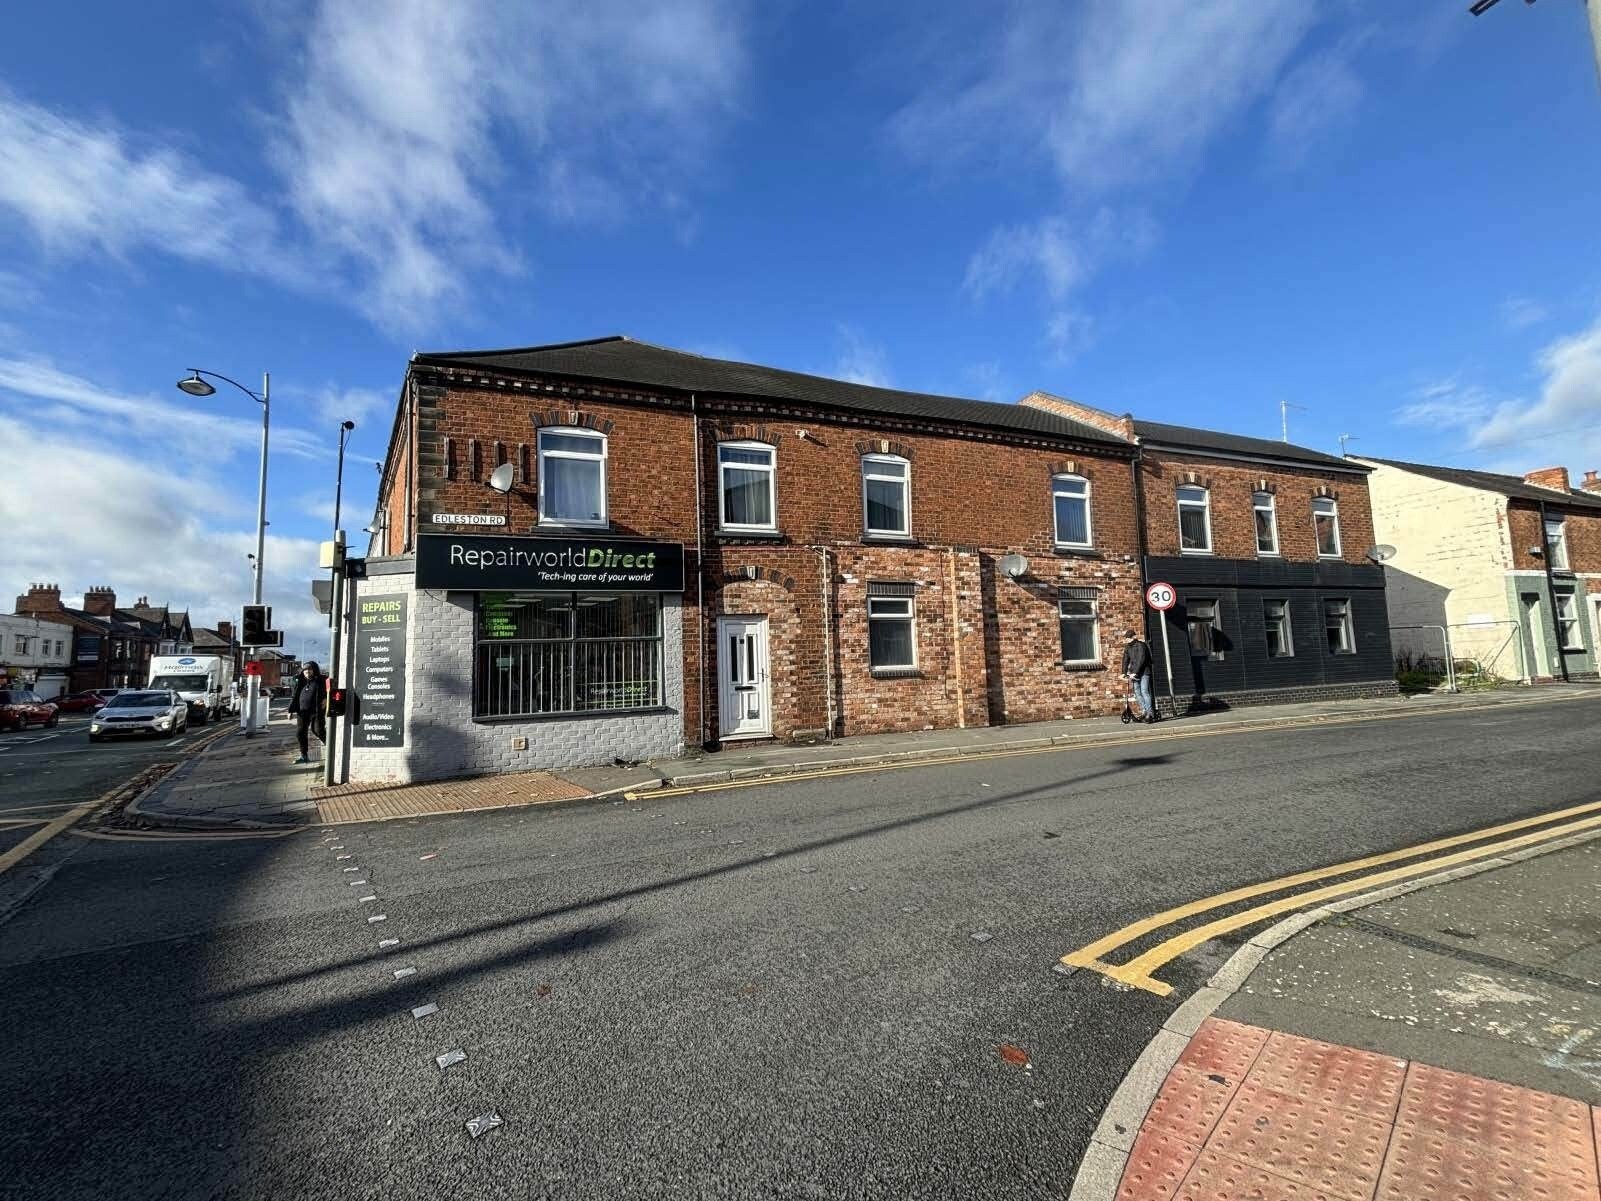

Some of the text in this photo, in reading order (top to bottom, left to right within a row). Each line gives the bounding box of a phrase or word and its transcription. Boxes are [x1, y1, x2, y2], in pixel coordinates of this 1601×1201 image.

[435, 514, 487, 523] EDLESTON
[450, 544, 656, 570] RepairworldDirect
[598, 572, 608, 582] of
[1151, 590, 1171, 602] 30
[362, 601, 401, 613] REPAIRS
[361, 616, 377, 625] BUY
[382, 614, 401, 623] SELL
[362, 693, 395, 701] Headphones
